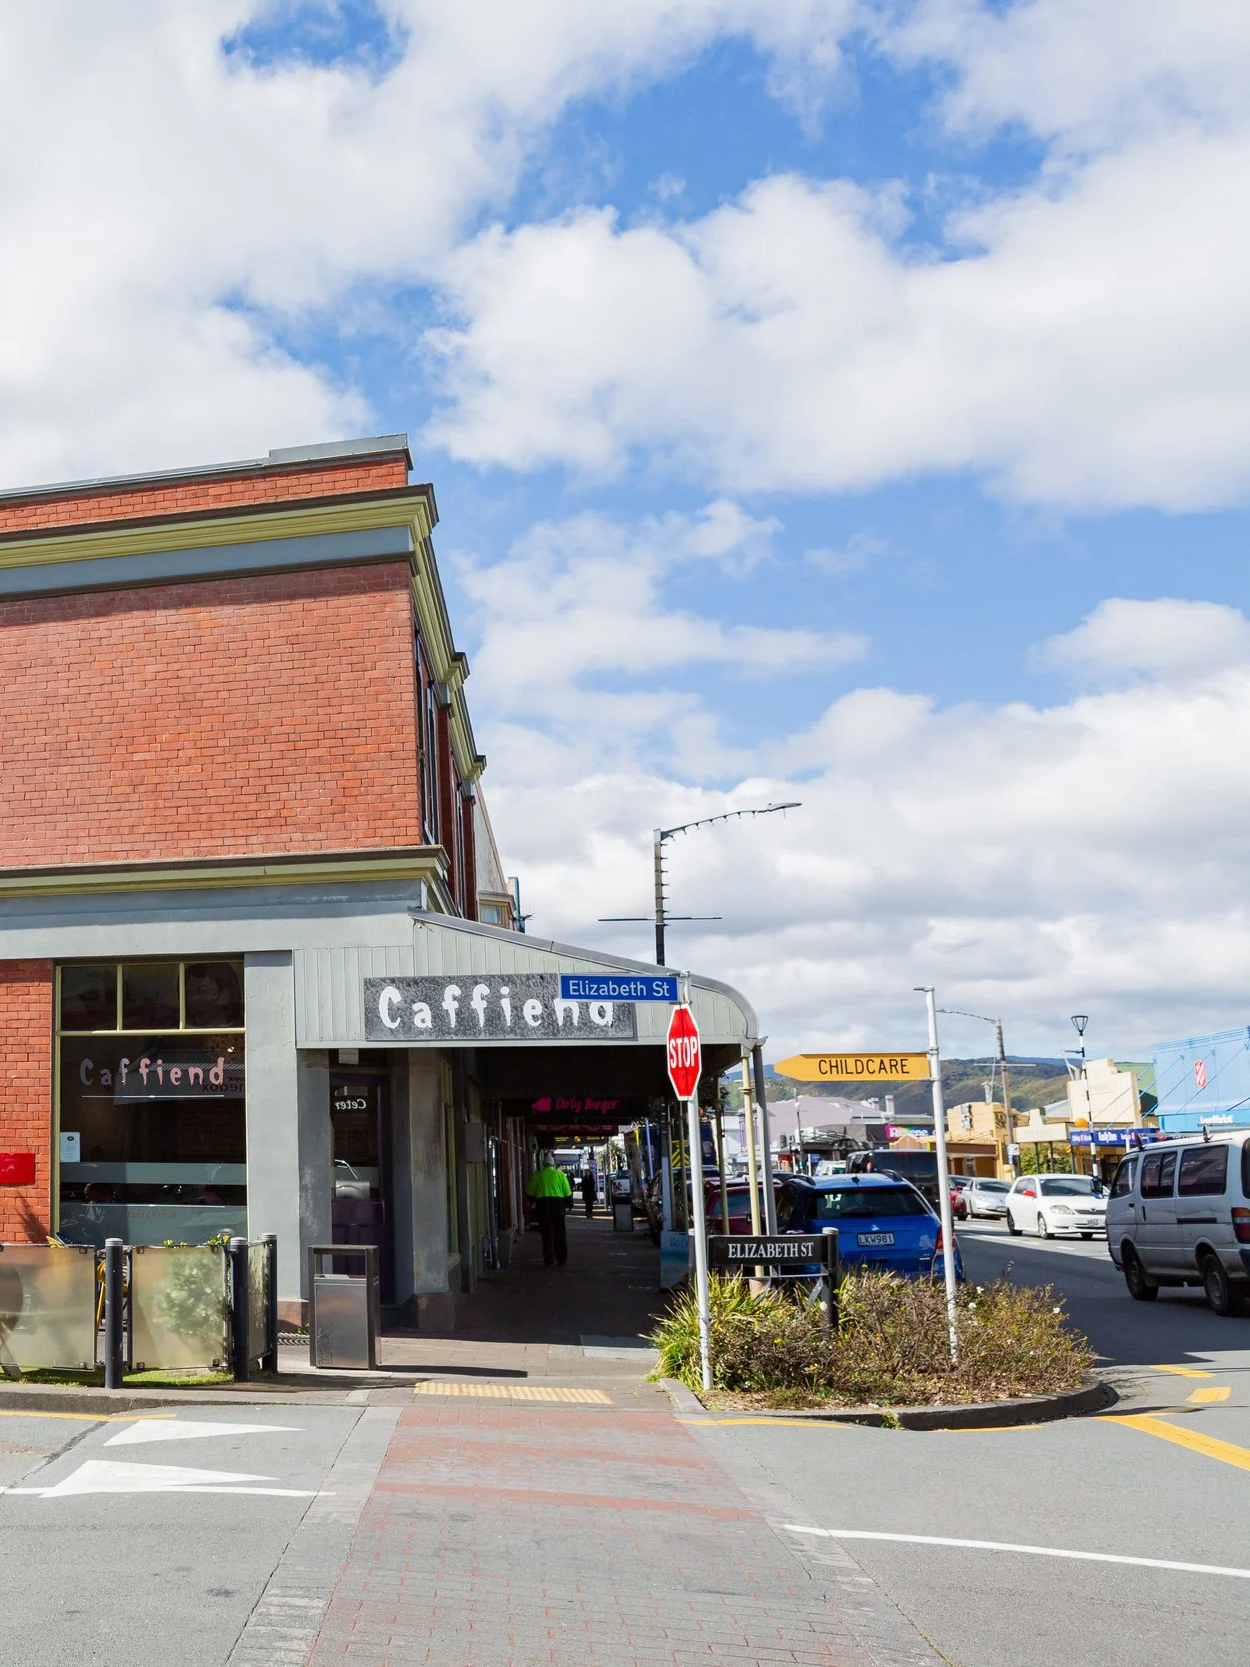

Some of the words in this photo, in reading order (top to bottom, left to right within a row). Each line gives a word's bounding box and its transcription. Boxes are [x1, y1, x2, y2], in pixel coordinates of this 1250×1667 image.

[568, 980, 647, 997] Elizabeth
[652, 981, 670, 997] St
[669, 1036, 699, 1069] STOP
[79, 1056, 225, 1087] Caffiend
[818, 1058, 911, 1075] CHILDCARE
[555, 1096, 581, 1113] Dirty
[585, 1096, 620, 1114] Burger
[727, 1242, 799, 1259] ELIZABETH
[800, 1242, 814, 1257] ST
